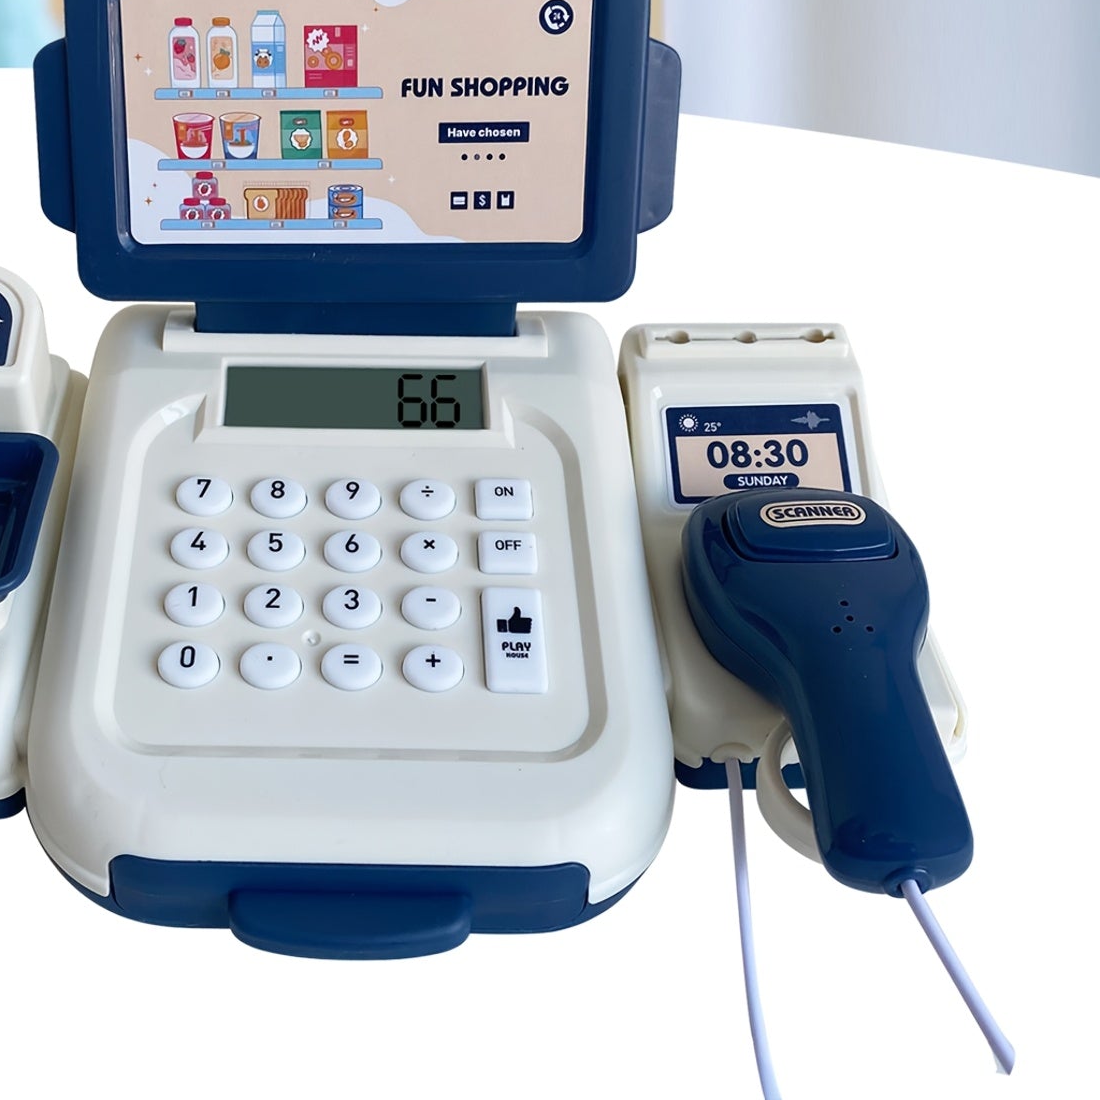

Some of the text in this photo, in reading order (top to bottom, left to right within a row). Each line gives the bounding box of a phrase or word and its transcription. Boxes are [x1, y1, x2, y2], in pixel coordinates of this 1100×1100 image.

[401, 76, 569, 97] FUN SHOPPING
[447, 127, 521, 138] Have chosen
[398, 374, 460, 428] 66
[707, 439, 809, 469] 08:30
[197, 479, 212, 499] 7
[271, 480, 285, 499] 8
[346, 481, 360, 499] 9
[737, 476, 788, 487] SUNDAY
[494, 486, 514, 497] ON
[772, 506, 855, 520] SCANNER
[190, 531, 207, 551] 4
[268, 533, 283, 552] 5
[345, 534, 359, 553] 6
[495, 540, 522, 551] OFF
[187, 586, 198, 607] 1
[265, 588, 281, 609] 2
[344, 589, 359, 610] 3
[502, 641, 531, 651] PLAY
[180, 646, 195, 668] 0
